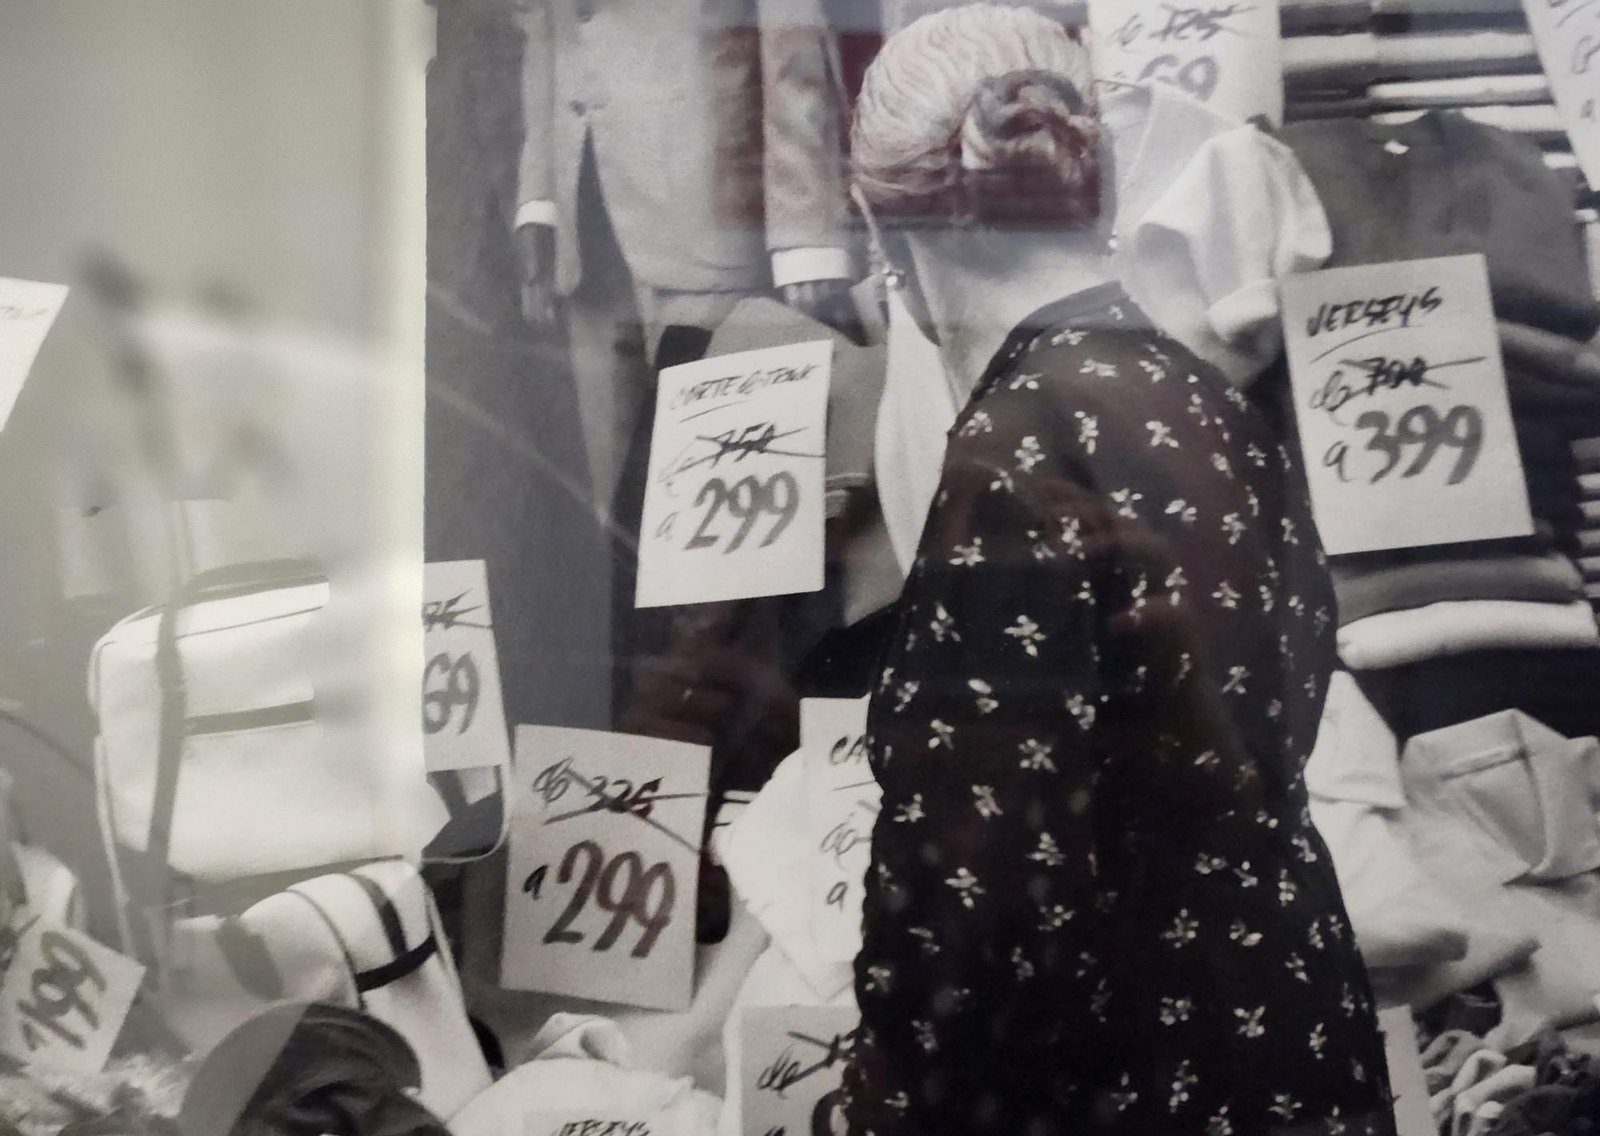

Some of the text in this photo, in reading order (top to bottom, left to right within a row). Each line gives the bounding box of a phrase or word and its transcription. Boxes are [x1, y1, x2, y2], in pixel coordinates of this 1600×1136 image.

[1355, 404, 1484, 486] 399
[682, 471, 800, 555] 299
[543, 838, 676, 959] 299
